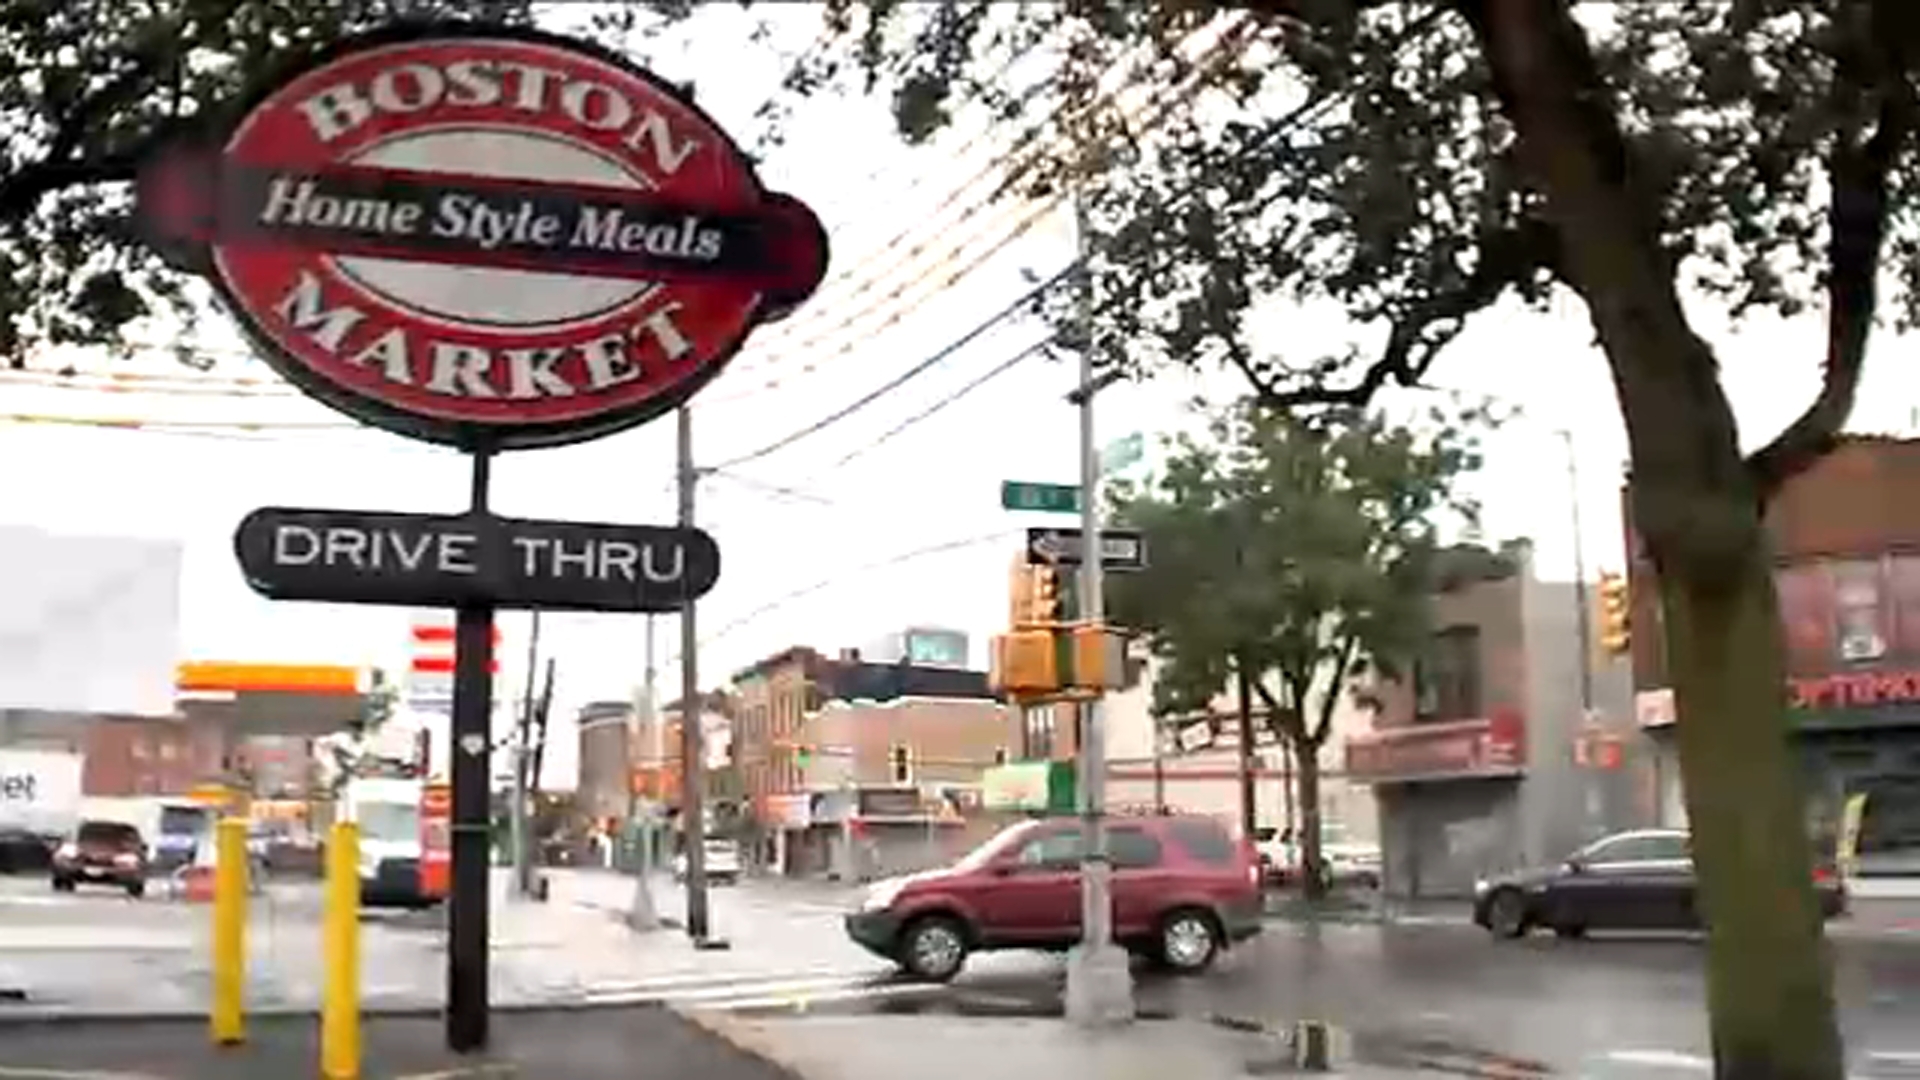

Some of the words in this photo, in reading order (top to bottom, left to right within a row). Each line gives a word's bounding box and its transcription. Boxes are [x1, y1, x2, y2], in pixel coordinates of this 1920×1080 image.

[297, 60, 700, 174] BOSTON
[261, 178, 422, 234] Home
[432, 193, 560, 248] Style
[570, 207, 722, 260] Meals
[275, 273, 696, 399] MARKET
[275, 526, 477, 573] DRIVE
[513, 537, 684, 582] THRU
